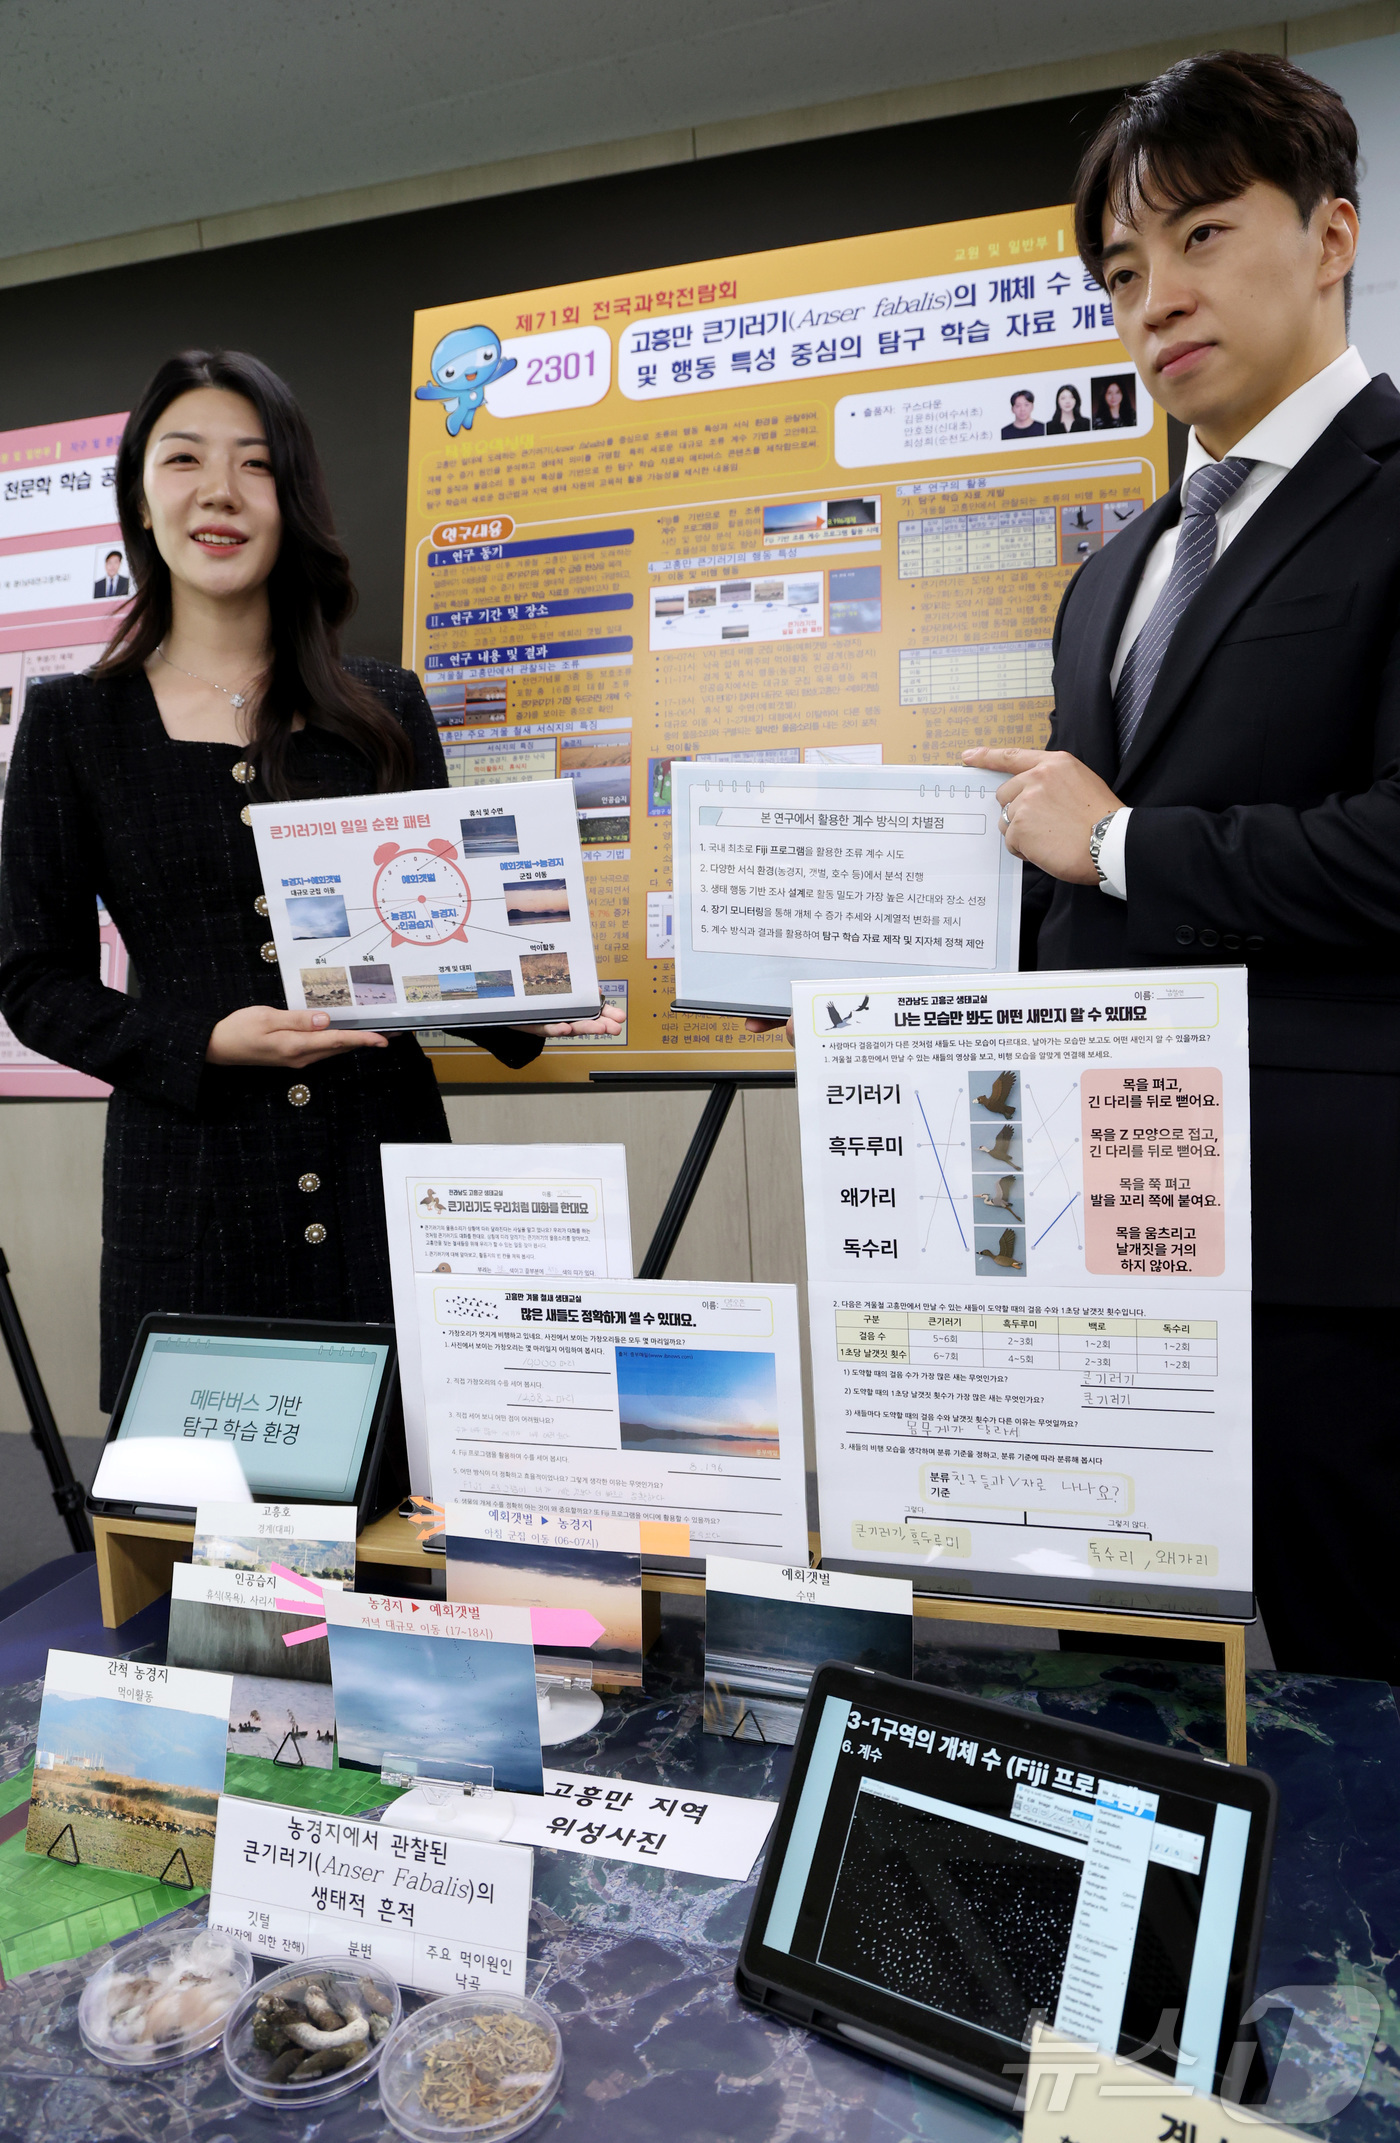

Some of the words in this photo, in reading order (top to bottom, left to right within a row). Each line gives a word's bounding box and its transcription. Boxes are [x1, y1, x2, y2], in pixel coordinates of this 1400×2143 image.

[515, 305, 579, 332] 제71회
[593, 280, 736, 321] 전국과학전람회
[630, 325, 692, 353] 고흥만
[988, 275, 1034, 302] 개체
[1047, 271, 1070, 295] 수
[637, 364, 656, 387] 및
[671, 356, 715, 382] 행동
[730, 347, 775, 373] 특성
[791, 335, 861, 366] 중심의
[878, 327, 925, 354] 탐구
[940, 319, 989, 345] 학습
[1006, 310, 1055, 336] 자료
[526, 349, 594, 385] 2301
[441, 520, 503, 543] 연구내용
[450, 611, 473, 625] 연구
[478, 608, 502, 622] 기간
[507, 606, 518, 619] 및
[524, 604, 548, 618] 장소
[449, 652, 472, 666] 연구
[477, 649, 501, 663] 내용
[506, 647, 517, 661] 및
[524, 644, 548, 659] 결과
[269, 821, 336, 839] 큰기러기의
[340, 818, 368, 834] 일일
[371, 816, 398, 831] 순환
[402, 813, 430, 828] 패턴
[760, 812, 770, 823] 본
[773, 812, 814, 825] 연구에서
[817, 813, 849, 826] 활용한
[852, 814, 873, 826] 계수
[876, 815, 908, 827] 방식의
[519, 872, 531, 880] 군집
[534, 870, 547, 878] 이동
[290, 888, 308, 896] 대규모
[309, 887, 321, 895] 군집
[323, 886, 335, 894] 이동
[399, 919, 433, 930] 인공습지
[897, 996, 928, 1006] 전라남도
[930, 995, 953, 1005] 고흥군
[955, 994, 987, 1004] 생태교실
[894, 1012, 920, 1026] 나는
[923, 1010, 962, 1026] 모습만
[966, 1010, 992, 1025] 봐도
[996, 1009, 1022, 1024] 어떤
[1026, 1007, 1066, 1023] 새인지
[1070, 1007, 1083, 1022] 알
[1087, 1007, 1101, 1021] 수
[1105, 1005, 1146, 1021] 있대요
[826, 1083, 900, 1104] 큰기러기
[1122, 1078, 1148, 1091] 목을
[1152, 1077, 1181, 1092] 펴고,
[1088, 1095, 1100, 1108] 긴
[1104, 1094, 1142, 1108] 다리를
[1146, 1094, 1172, 1108] 뒤로
[1175, 1094, 1219, 1107] 뻗어요.
[828, 1135, 902, 1156] 흑두루미
[447, 1200, 492, 1212] 큰기러기도
[493, 1201, 529, 1213] 우리처럼
[531, 1201, 558, 1213] 대화를
[560, 1201, 588, 1214] 한대요
[840, 1187, 895, 1207] 왜가리
[843, 1238, 897, 1258] 독수리
[504, 1292, 524, 1301] 고흥만
[525, 1293, 538, 1301] 겨울
[540, 1293, 553, 1302] 철새
[554, 1294, 581, 1302] 생태교실
[520, 1307, 543, 1321] 많은
[545, 1308, 579, 1322] 새들도
[581, 1309, 626, 1324] 정확하게
[628, 1311, 640, 1324] 셀
[642, 1312, 655, 1325] 수
[657, 1312, 696, 1327] 있대요.
[927, 1316, 961, 1326] 큰기러기
[1002, 1318, 1036, 1329] 흑두루미
[1088, 1322, 1106, 1331] 백로
[1162, 1323, 1189, 1334] 독수리
[190, 1389, 259, 1412] 메타버스
[265, 1395, 302, 1416] 기반
[183, 1416, 217, 1437] 탐구
[223, 1418, 257, 1441] 학습
[262, 1421, 299, 1445] 환경
[262, 1505, 290, 1518] 고흥호
[488, 1509, 532, 1525] 예회갯벌
[557, 1517, 592, 1531] 농경지
[482, 1527, 502, 1541] 아침
[507, 1530, 525, 1542] 군집
[531, 1533, 549, 1544] 이동
[554, 1535, 598, 1550] (06~07시)
[234, 1572, 276, 1589] 인공습지
[781, 1568, 831, 1587] 예회갯벌
[368, 1596, 402, 1613] 농경지
[429, 1603, 479, 1620] 예회갯벌
[359, 1616, 381, 1631] 저녁
[385, 1619, 414, 1634] 대규모
[420, 1623, 439, 1635] 이동
[445, 1625, 492, 1640] (17~18시)
[107, 1661, 127, 1677] 간척
[134, 1665, 168, 1683] 농경지
[114, 1686, 153, 1703] 먹이활동
[840, 1737, 853, 1754] 6.
[857, 1743, 882, 1762] 계수
[846, 1709, 936, 1752] 3-1구역의
[937, 1735, 978, 1766] 개체
[980, 1747, 1001, 1771] 수
[1006, 1757, 1050, 1789] (Fiji
[545, 1782, 633, 1811] 고흥만
[648, 1797, 708, 1824] 지역
[287, 1815, 378, 1846] 농경지에서
[390, 1834, 446, 1865] 관찰된
[546, 1816, 666, 1854] 위성사진
[243, 1839, 384, 1882] 큰기러기(Anser
[392, 1867, 493, 1904] Fabalis)의
[311, 1885, 364, 1917] 생태적
[377, 1897, 413, 1927] 흔적
[248, 1910, 269, 1929] 깃털
[347, 1941, 371, 1959] 분변
